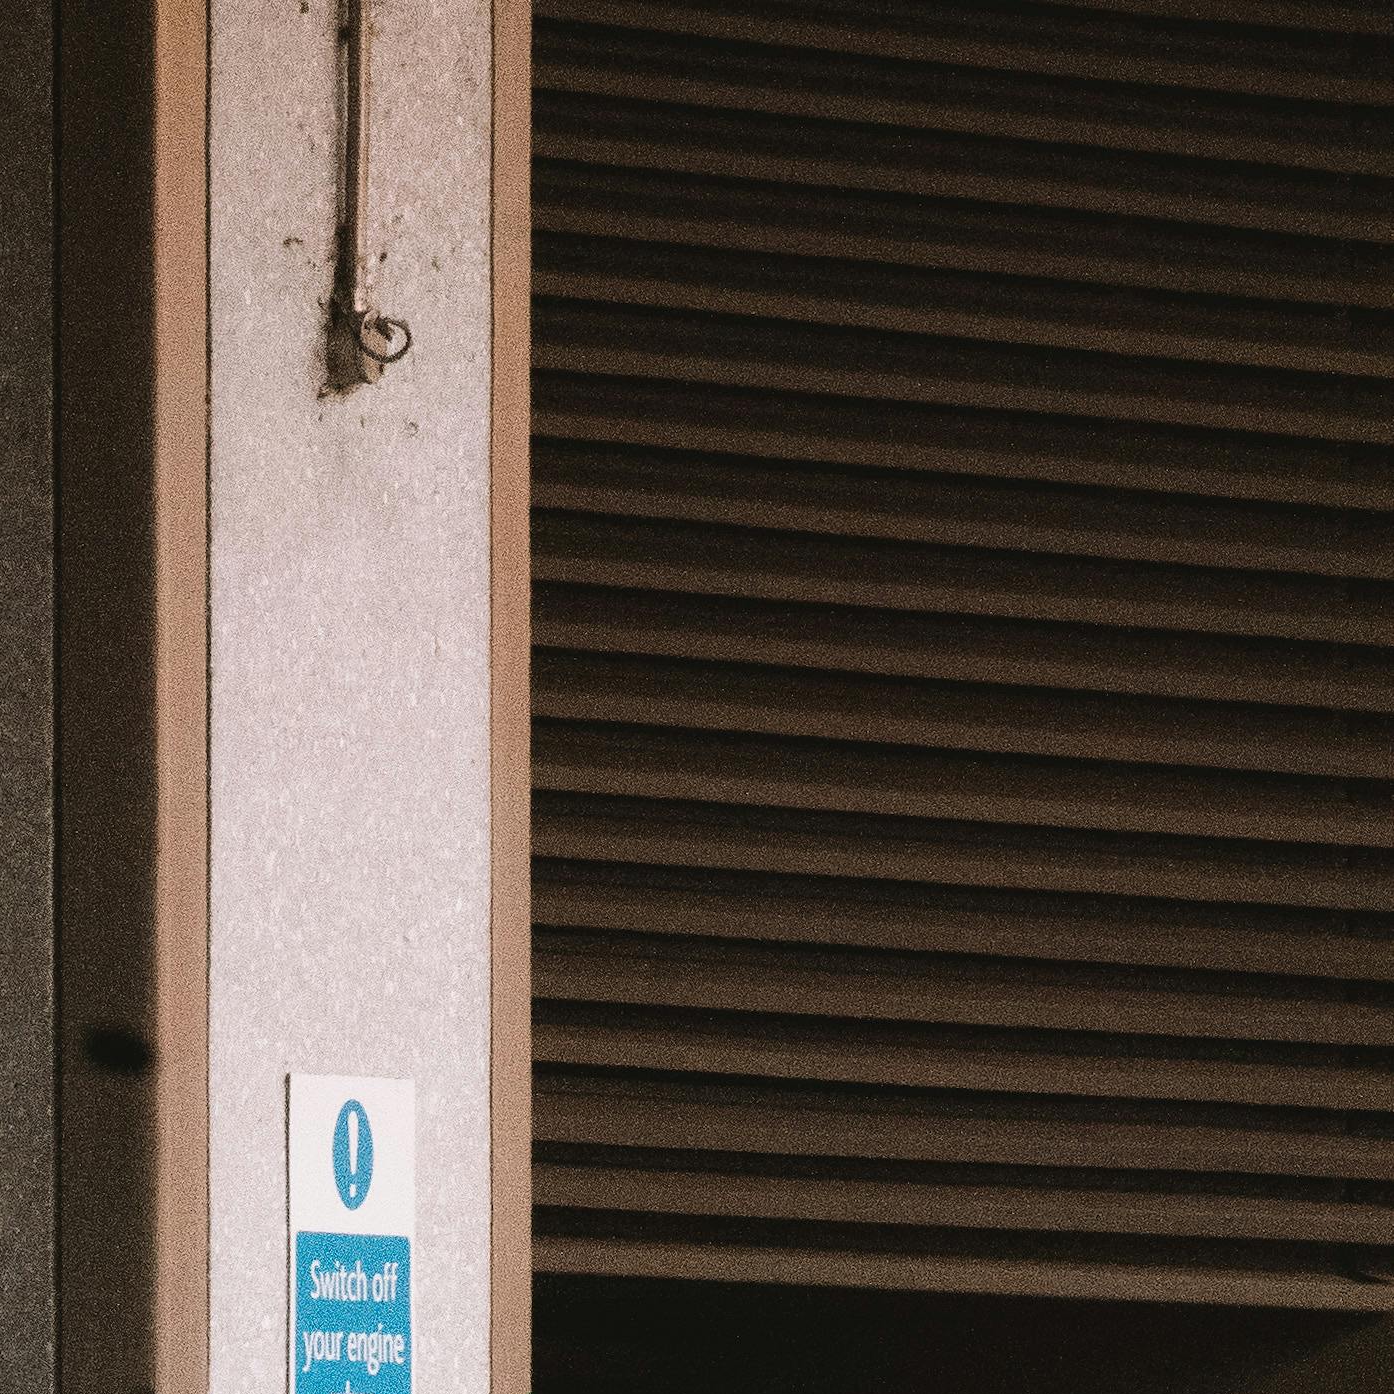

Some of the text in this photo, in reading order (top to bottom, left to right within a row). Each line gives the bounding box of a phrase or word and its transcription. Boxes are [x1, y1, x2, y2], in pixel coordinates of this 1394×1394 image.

[310, 1259, 398, 1302] Switch off
[302, 1323, 405, 1376] your engine
